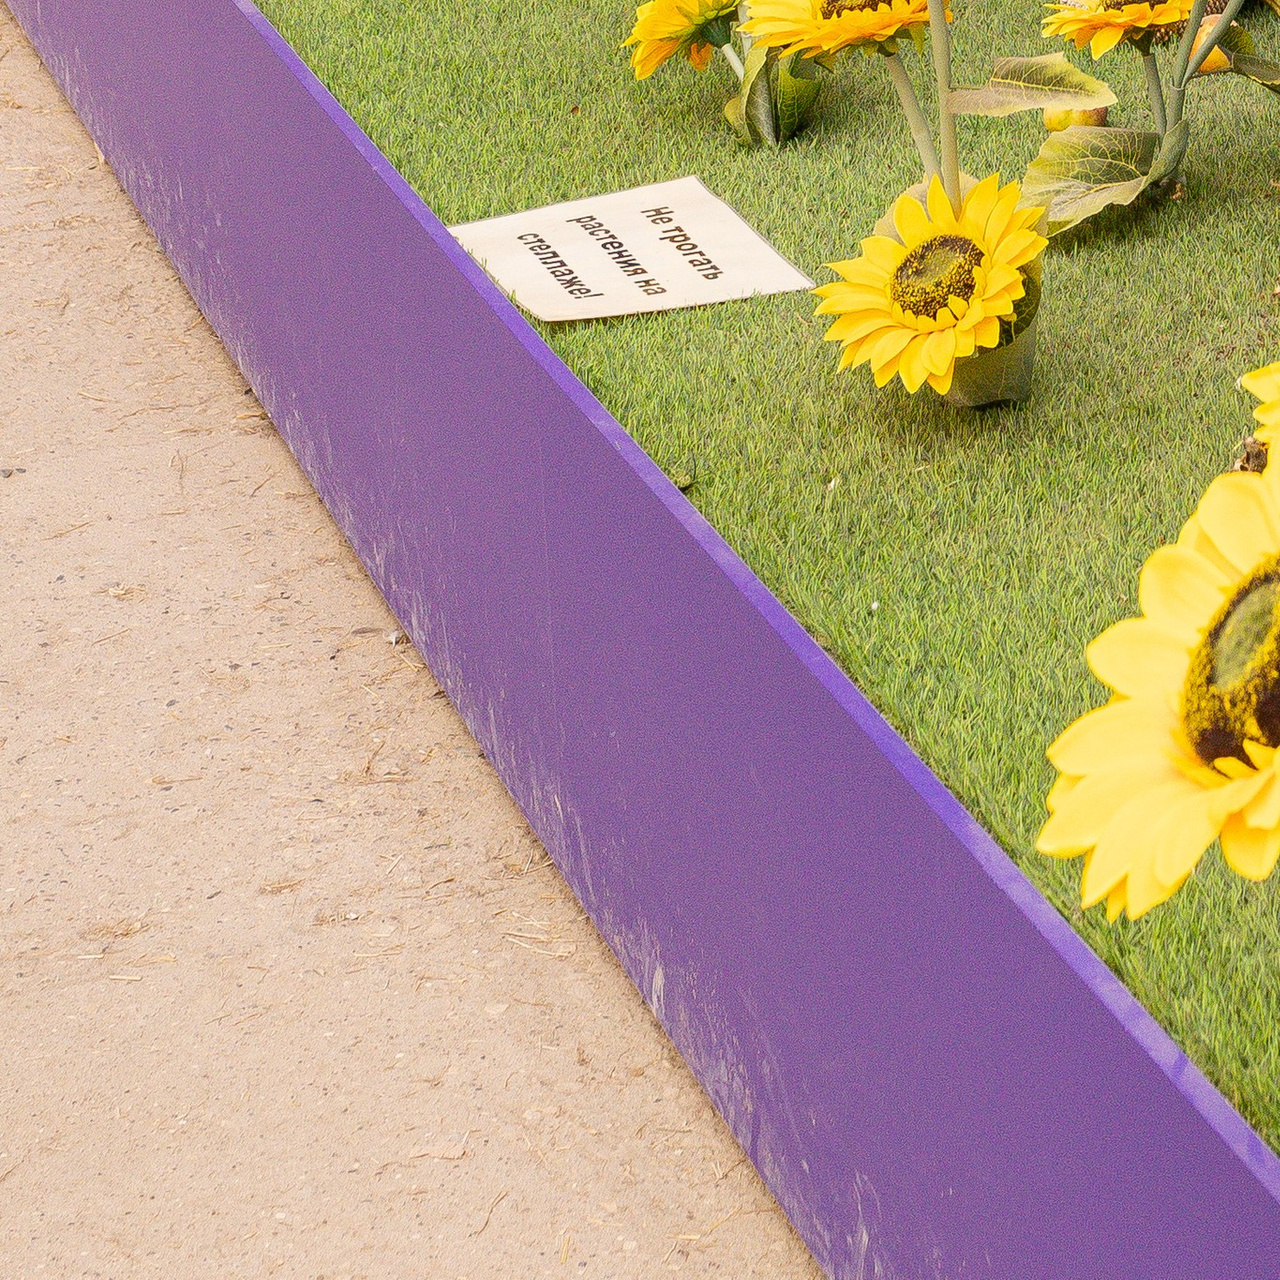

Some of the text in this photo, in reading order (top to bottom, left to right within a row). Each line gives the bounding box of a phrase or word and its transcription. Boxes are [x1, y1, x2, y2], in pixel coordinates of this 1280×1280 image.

[517, 233, 604, 299] стеллаже!
[566, 215, 667, 296] растения на
[641, 206, 725, 280] Не трогать
